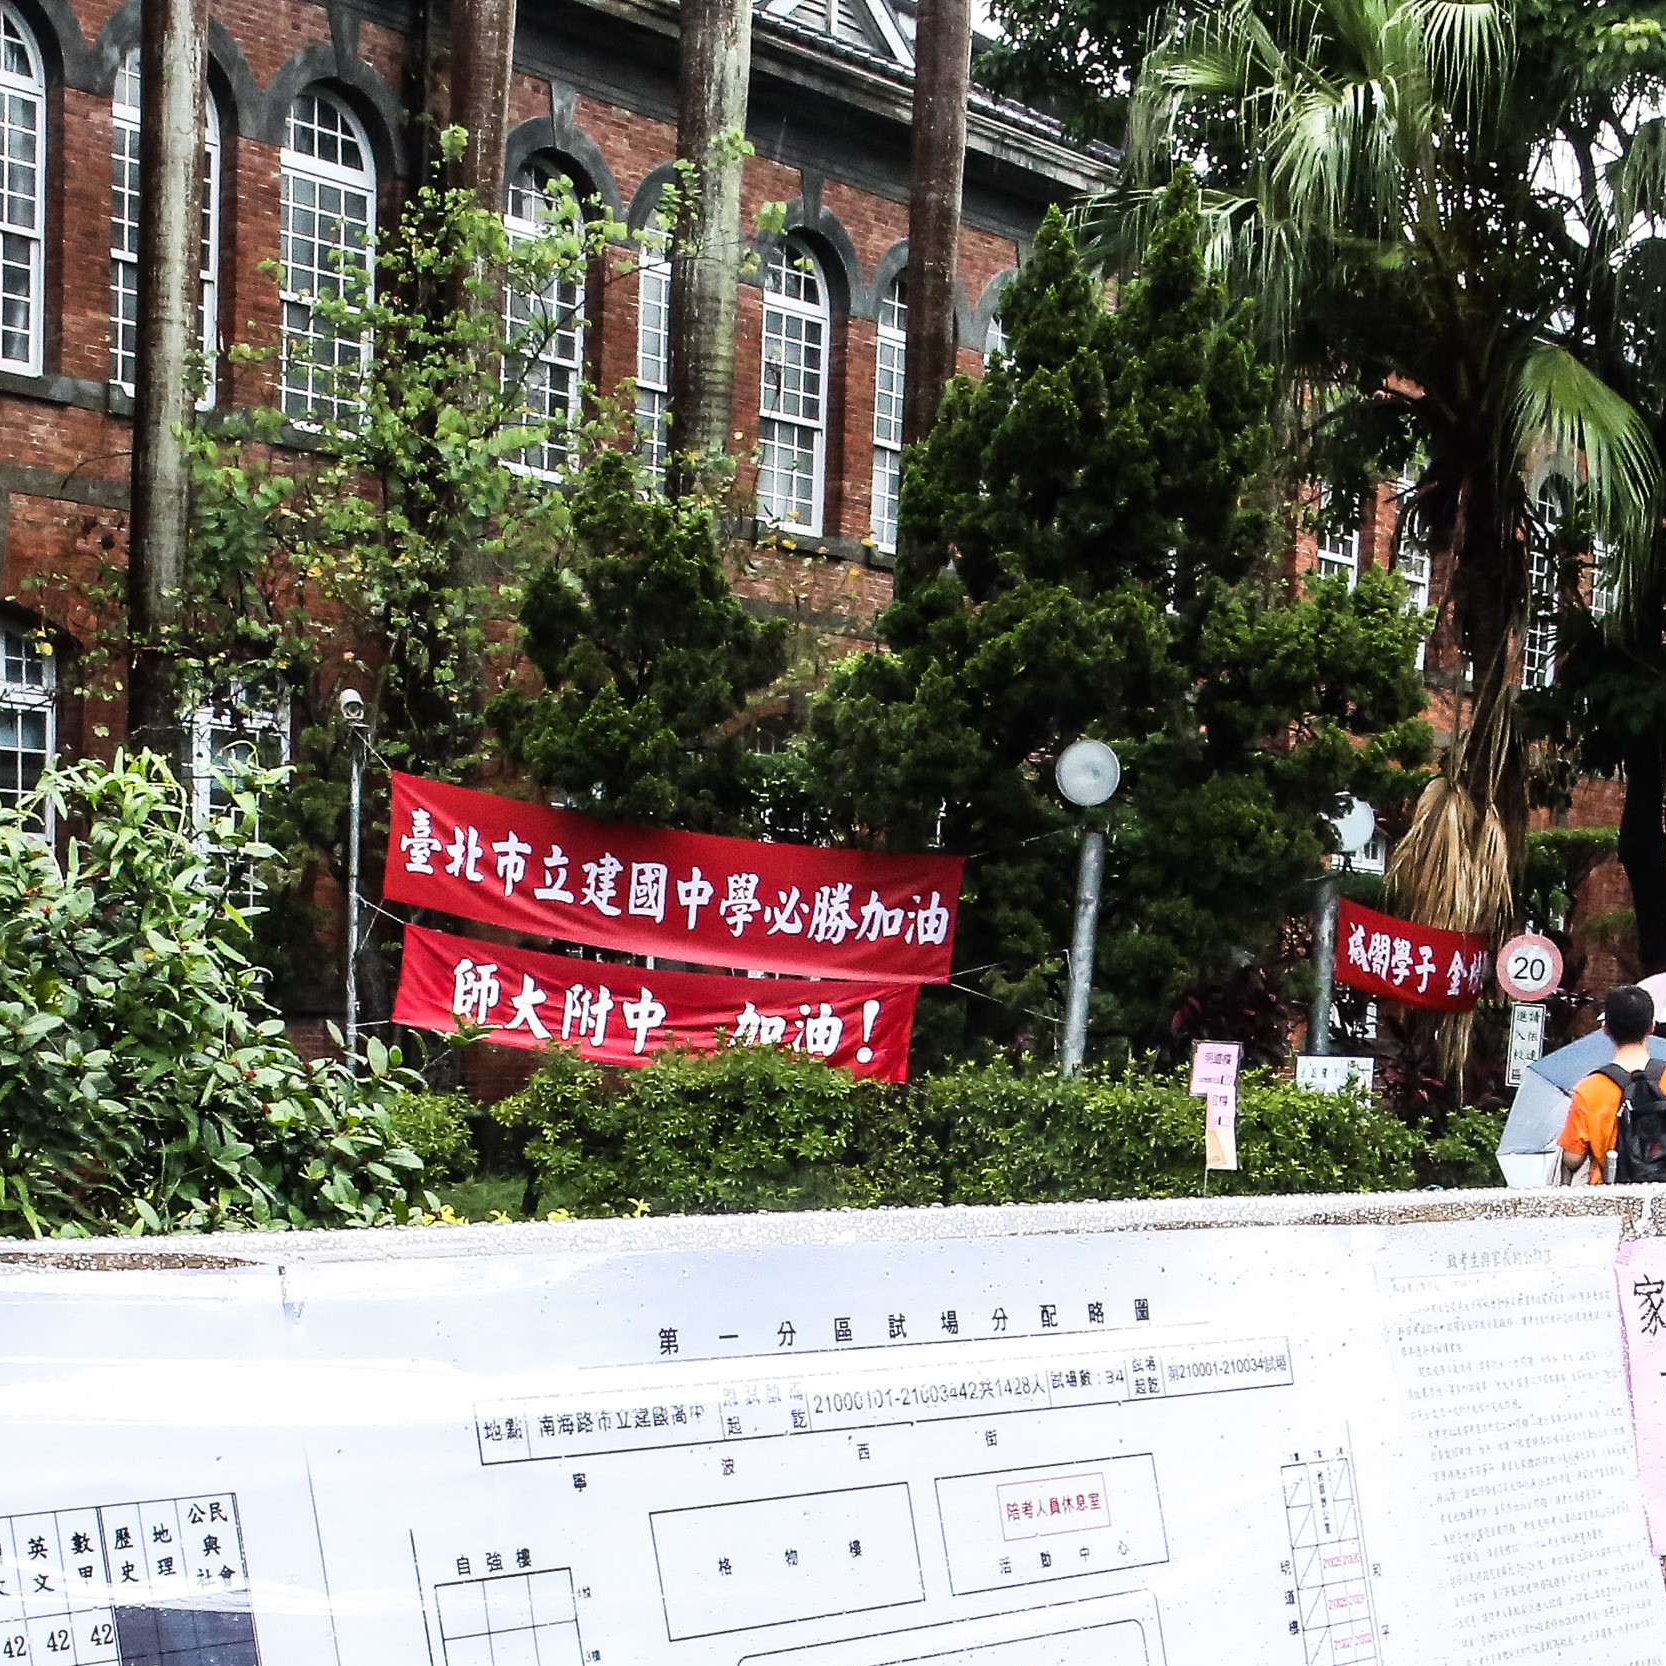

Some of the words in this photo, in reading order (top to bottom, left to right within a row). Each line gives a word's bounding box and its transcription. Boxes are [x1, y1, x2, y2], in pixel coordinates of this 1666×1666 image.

[399, 807, 950, 945] 臺北市立建國中學必勝加油
[1513, 956, 1546, 982] 20
[452, 957, 668, 1055] 師大附中
[455, 1546, 533, 1577] 自強樓
[4, 1635, 27, 1660] 42
